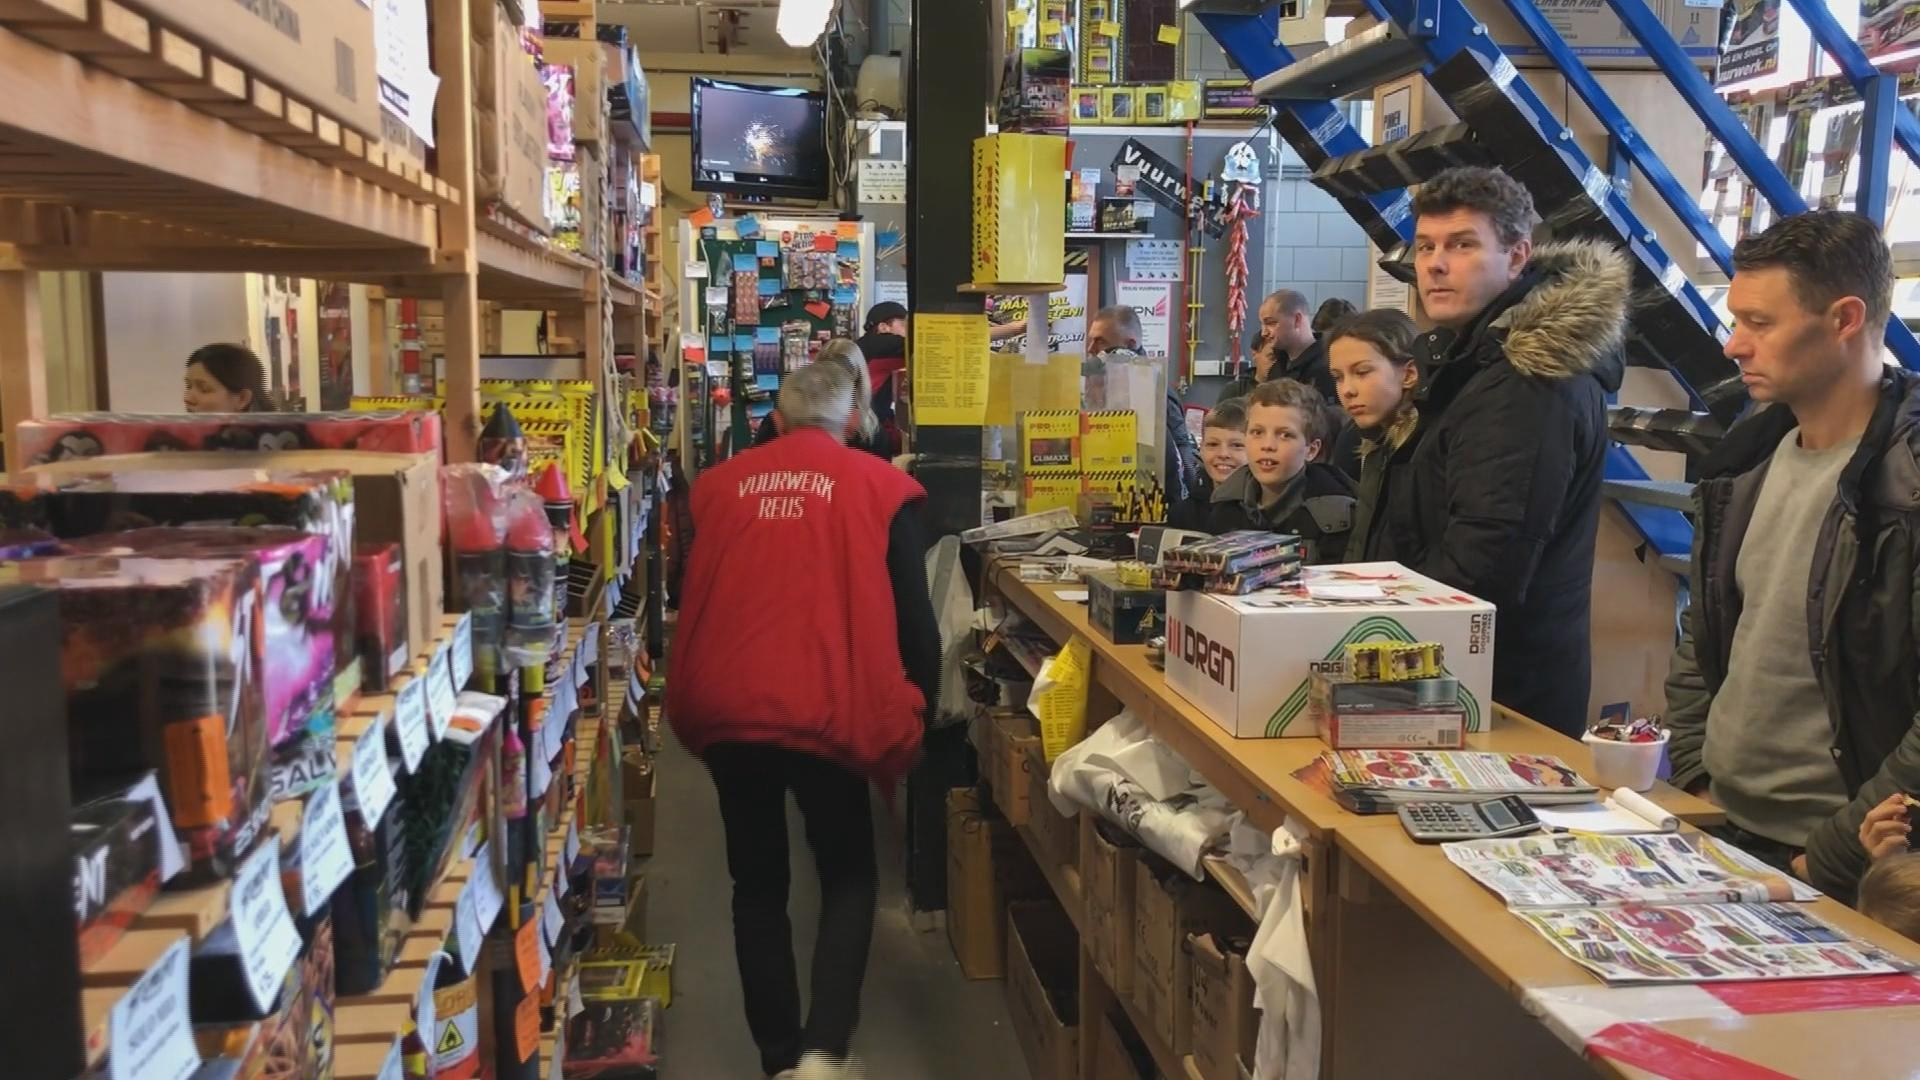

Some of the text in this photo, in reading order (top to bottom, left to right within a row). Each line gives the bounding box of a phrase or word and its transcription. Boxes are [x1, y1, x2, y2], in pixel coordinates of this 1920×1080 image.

[1719, 54, 1777, 81] uurwerk.nl
[1032, 454, 1070, 462] CLIMAXX
[738, 470, 836, 503] VUURWERK
[758, 496, 805, 519] REUS
[1184, 625, 1236, 693] DRGN
[1310, 662, 1345, 674] DRG
